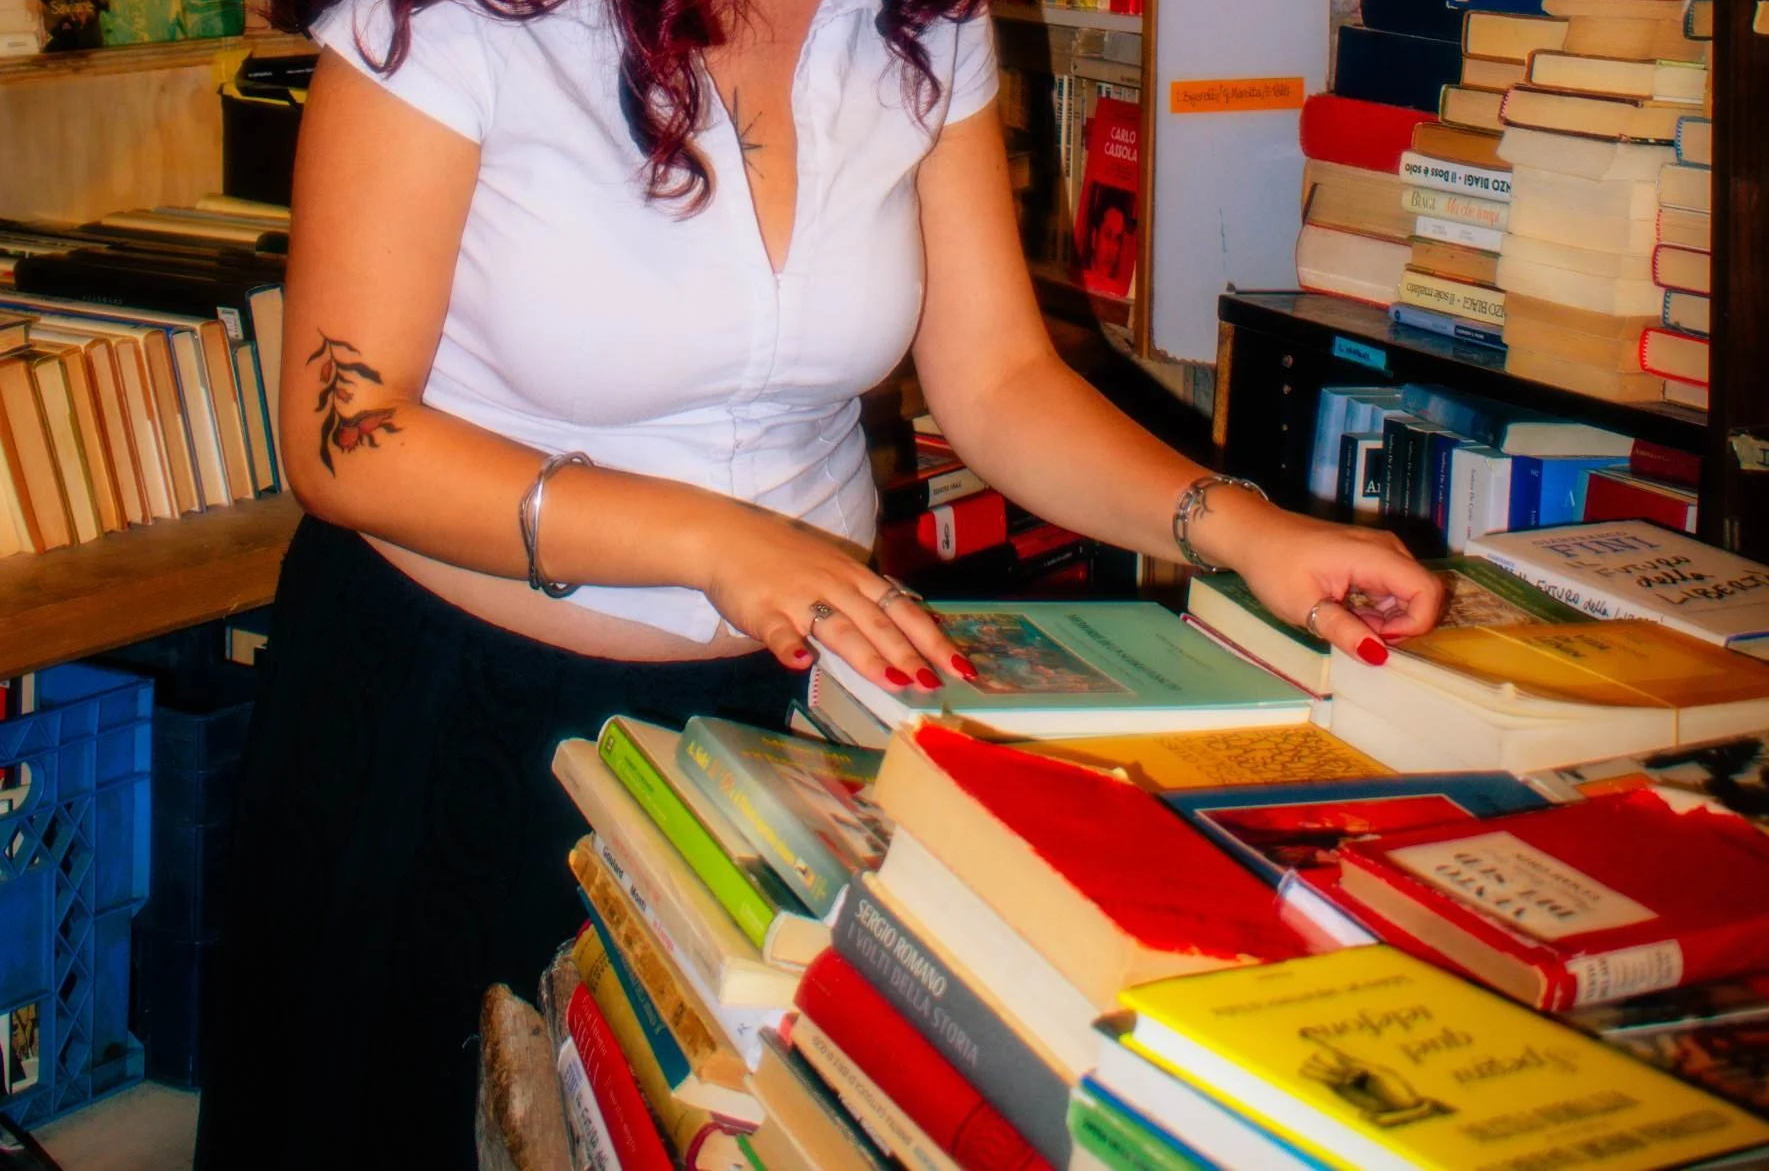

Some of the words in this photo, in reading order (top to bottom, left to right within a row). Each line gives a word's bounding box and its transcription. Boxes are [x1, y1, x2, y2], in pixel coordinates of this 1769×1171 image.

[1111, 126, 1136, 144] CARLO
[1104, 142, 1138, 163] CASSOLA
[1405, 163, 1422, 175] solo
[1542, 535, 1661, 559] FINI
[1594, 553, 1692, 578] FUTURO
[1635, 568, 1715, 590] della
[1583, 596, 1609, 618] della
[854, 898, 896, 951] SERGIO
[896, 933, 949, 1001] ROMANO
[847, 920, 856, 939] I
[855, 933, 890, 976] VOLTI
[890, 969, 931, 1020] DELLA
[933, 1006, 981, 1068] STORIA
